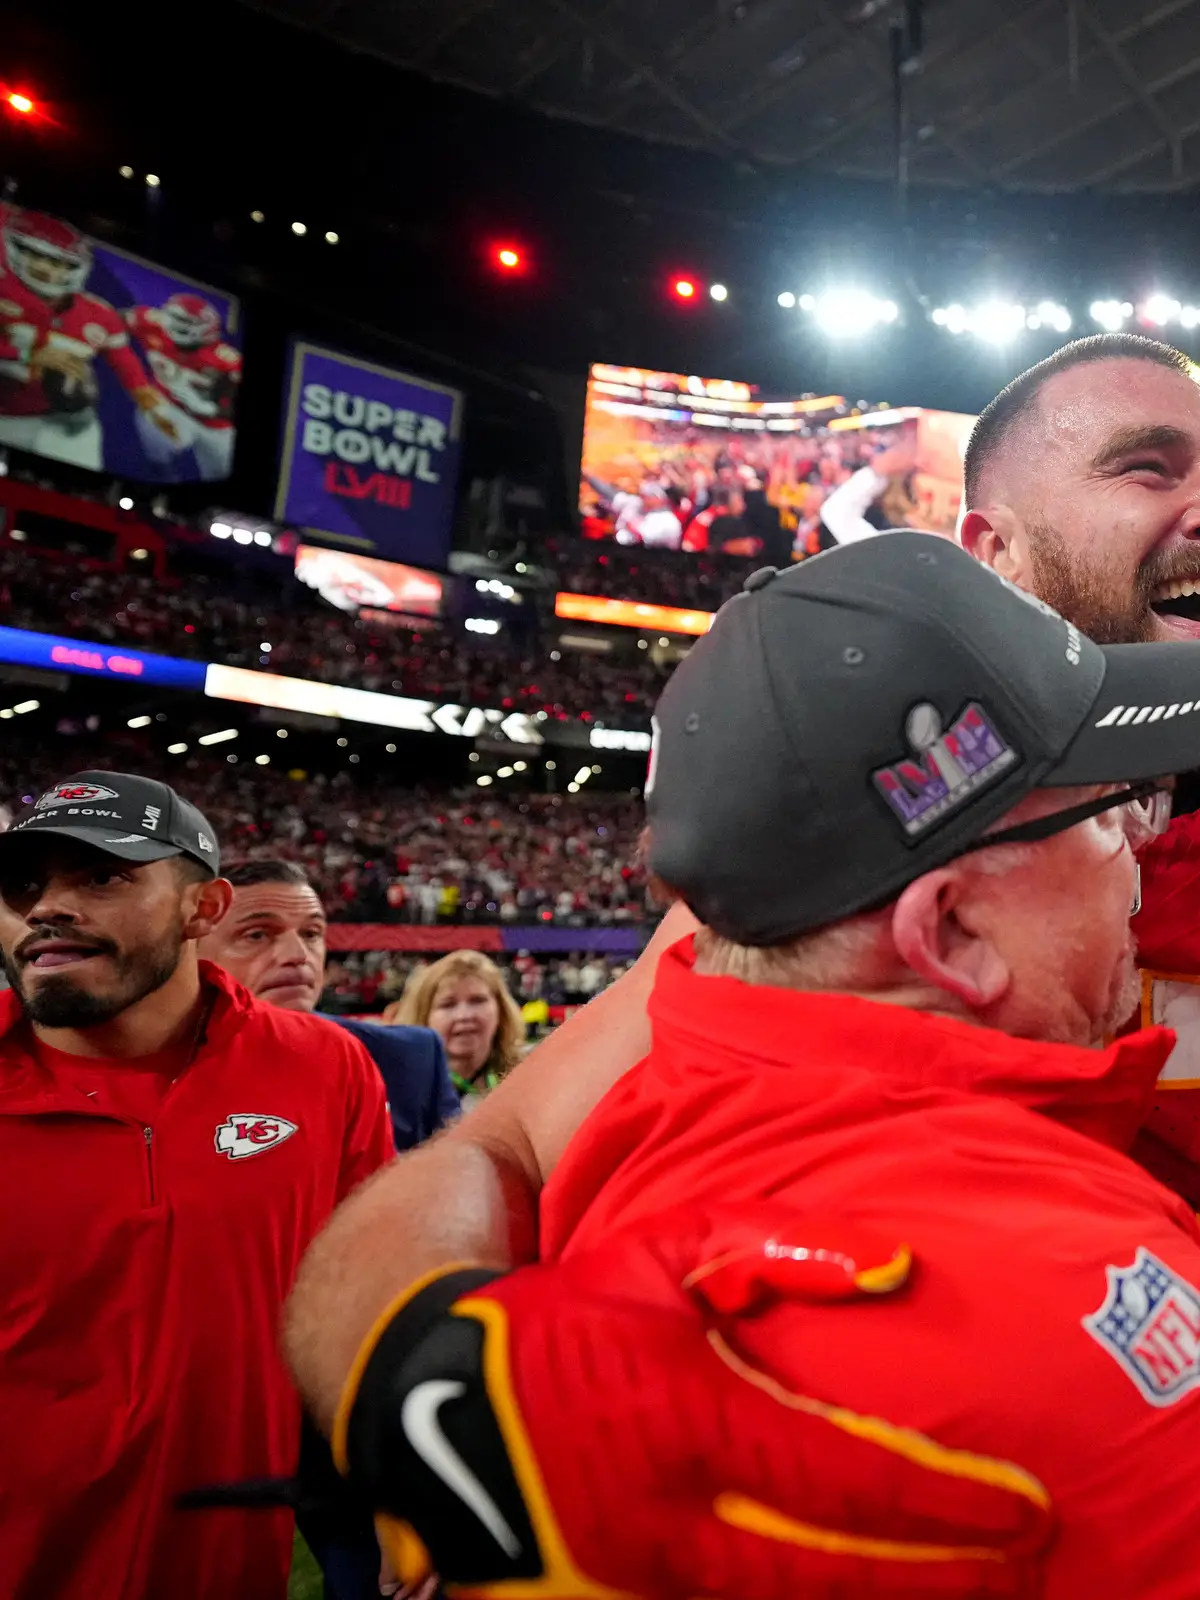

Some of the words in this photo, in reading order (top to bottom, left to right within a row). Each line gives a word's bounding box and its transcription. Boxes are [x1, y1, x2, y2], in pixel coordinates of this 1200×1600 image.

[302, 383, 446, 450] SUPER
[303, 418, 440, 484] BOWL
[325, 461, 412, 508] LVIII
[67, 807, 122, 819] BOWL
[141, 805, 162, 831] LVIII
[235, 1120, 280, 1144] KC
